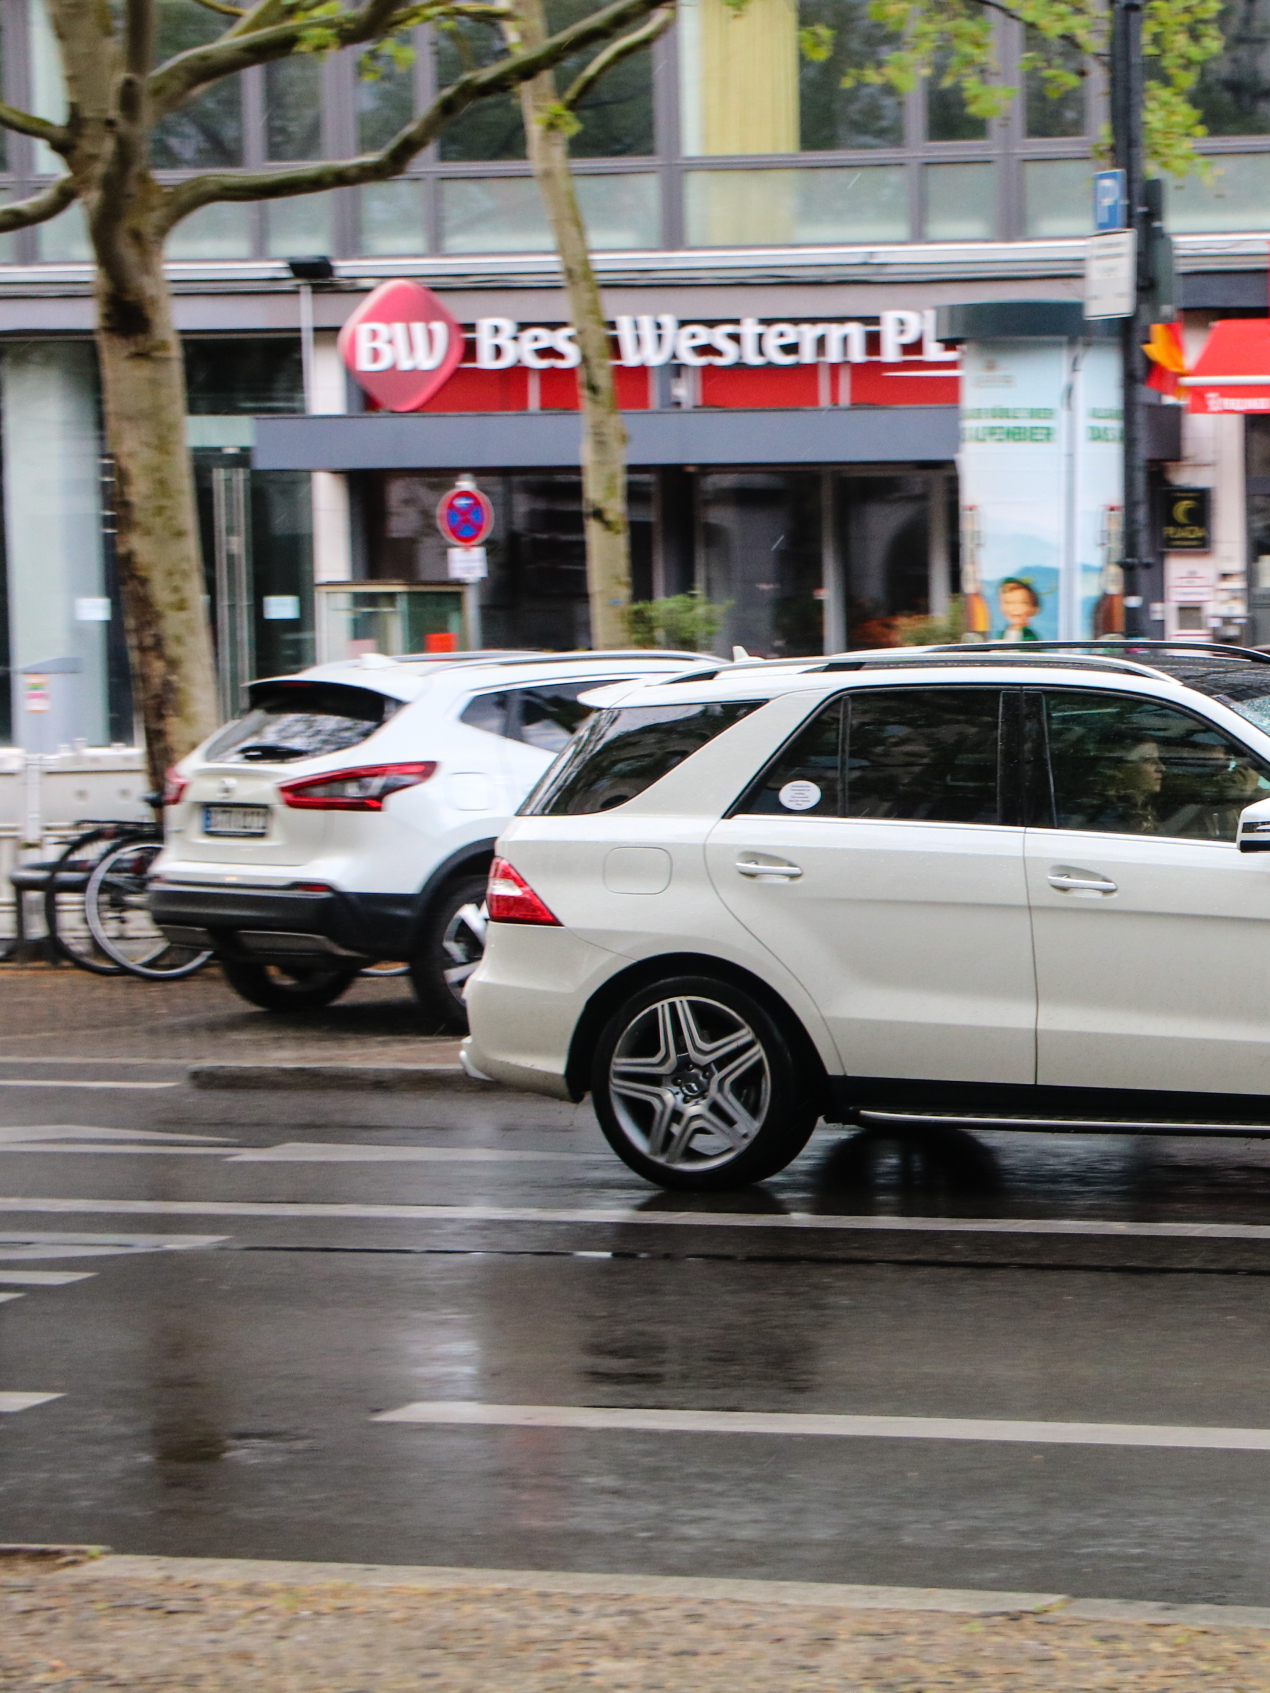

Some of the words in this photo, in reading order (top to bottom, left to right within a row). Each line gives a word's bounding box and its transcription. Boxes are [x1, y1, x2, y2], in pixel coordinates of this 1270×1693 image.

[355, 321, 449, 371] BW
[475, 317, 582, 370] Bes
[616, 313, 867, 367] Western
[879, 310, 963, 363] PL
